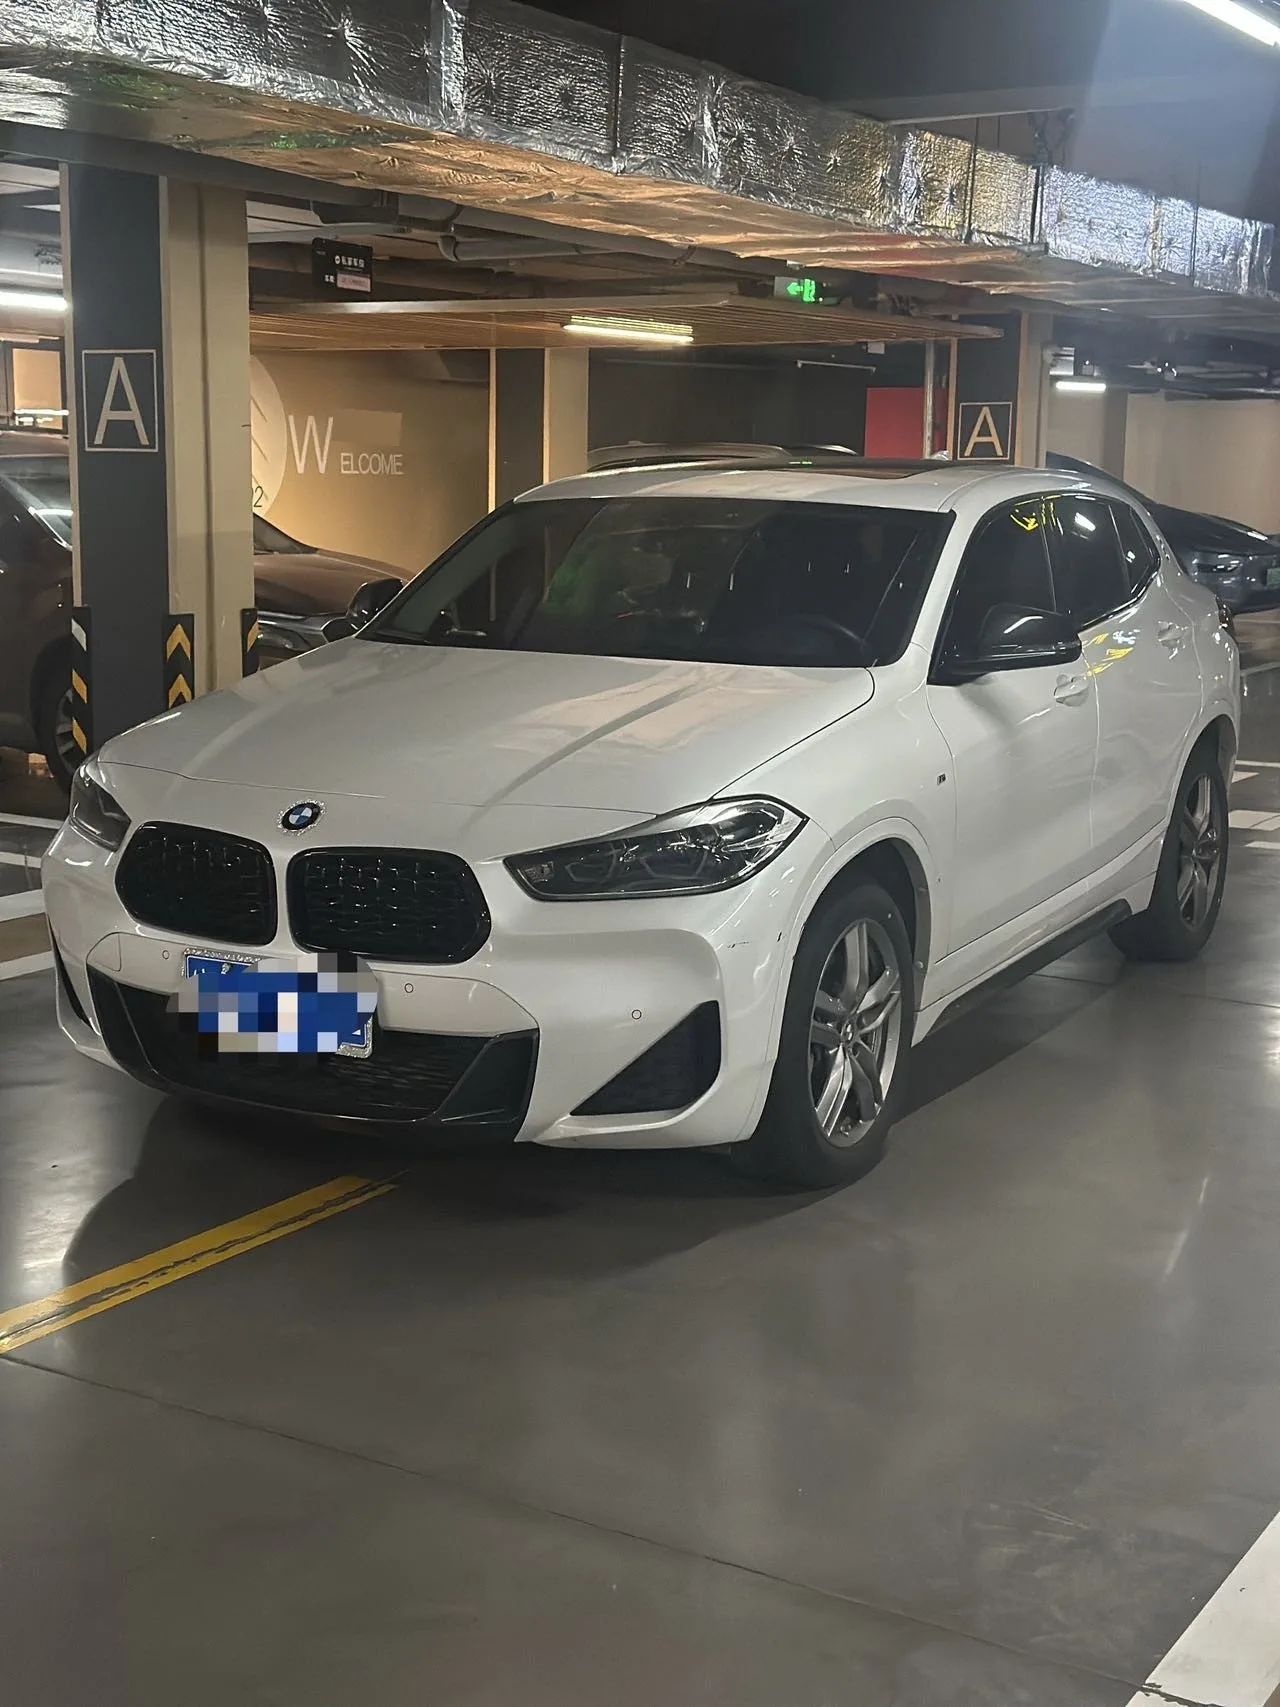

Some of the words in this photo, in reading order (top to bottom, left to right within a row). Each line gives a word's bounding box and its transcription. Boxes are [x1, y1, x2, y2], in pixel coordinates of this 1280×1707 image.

[94, 356, 149, 445] A
[964, 406, 1003, 456] A
[251, 485, 264, 507] 2
